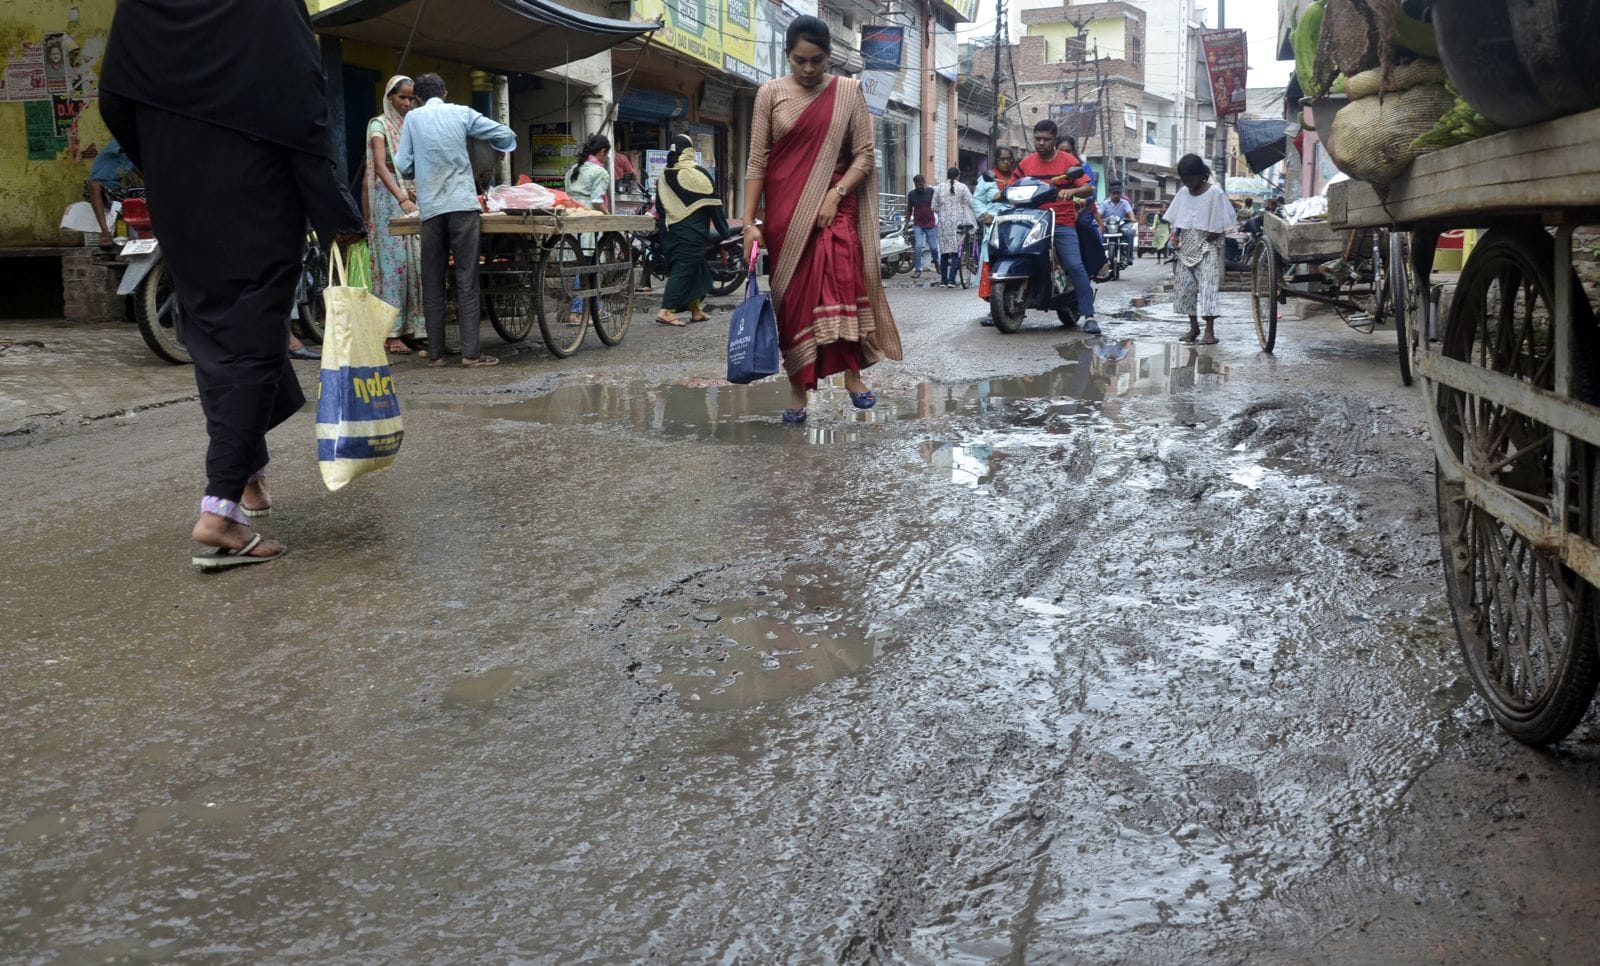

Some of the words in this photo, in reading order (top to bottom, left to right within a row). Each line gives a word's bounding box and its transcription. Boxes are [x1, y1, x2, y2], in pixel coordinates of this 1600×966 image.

[677, 34, 687, 50] DAS
[688, 39, 707, 58] MEDICAL
[707, 47, 721, 64] STORE
[726, 55, 737, 73] DAS
[737, 61, 758, 83] MEDICAL
